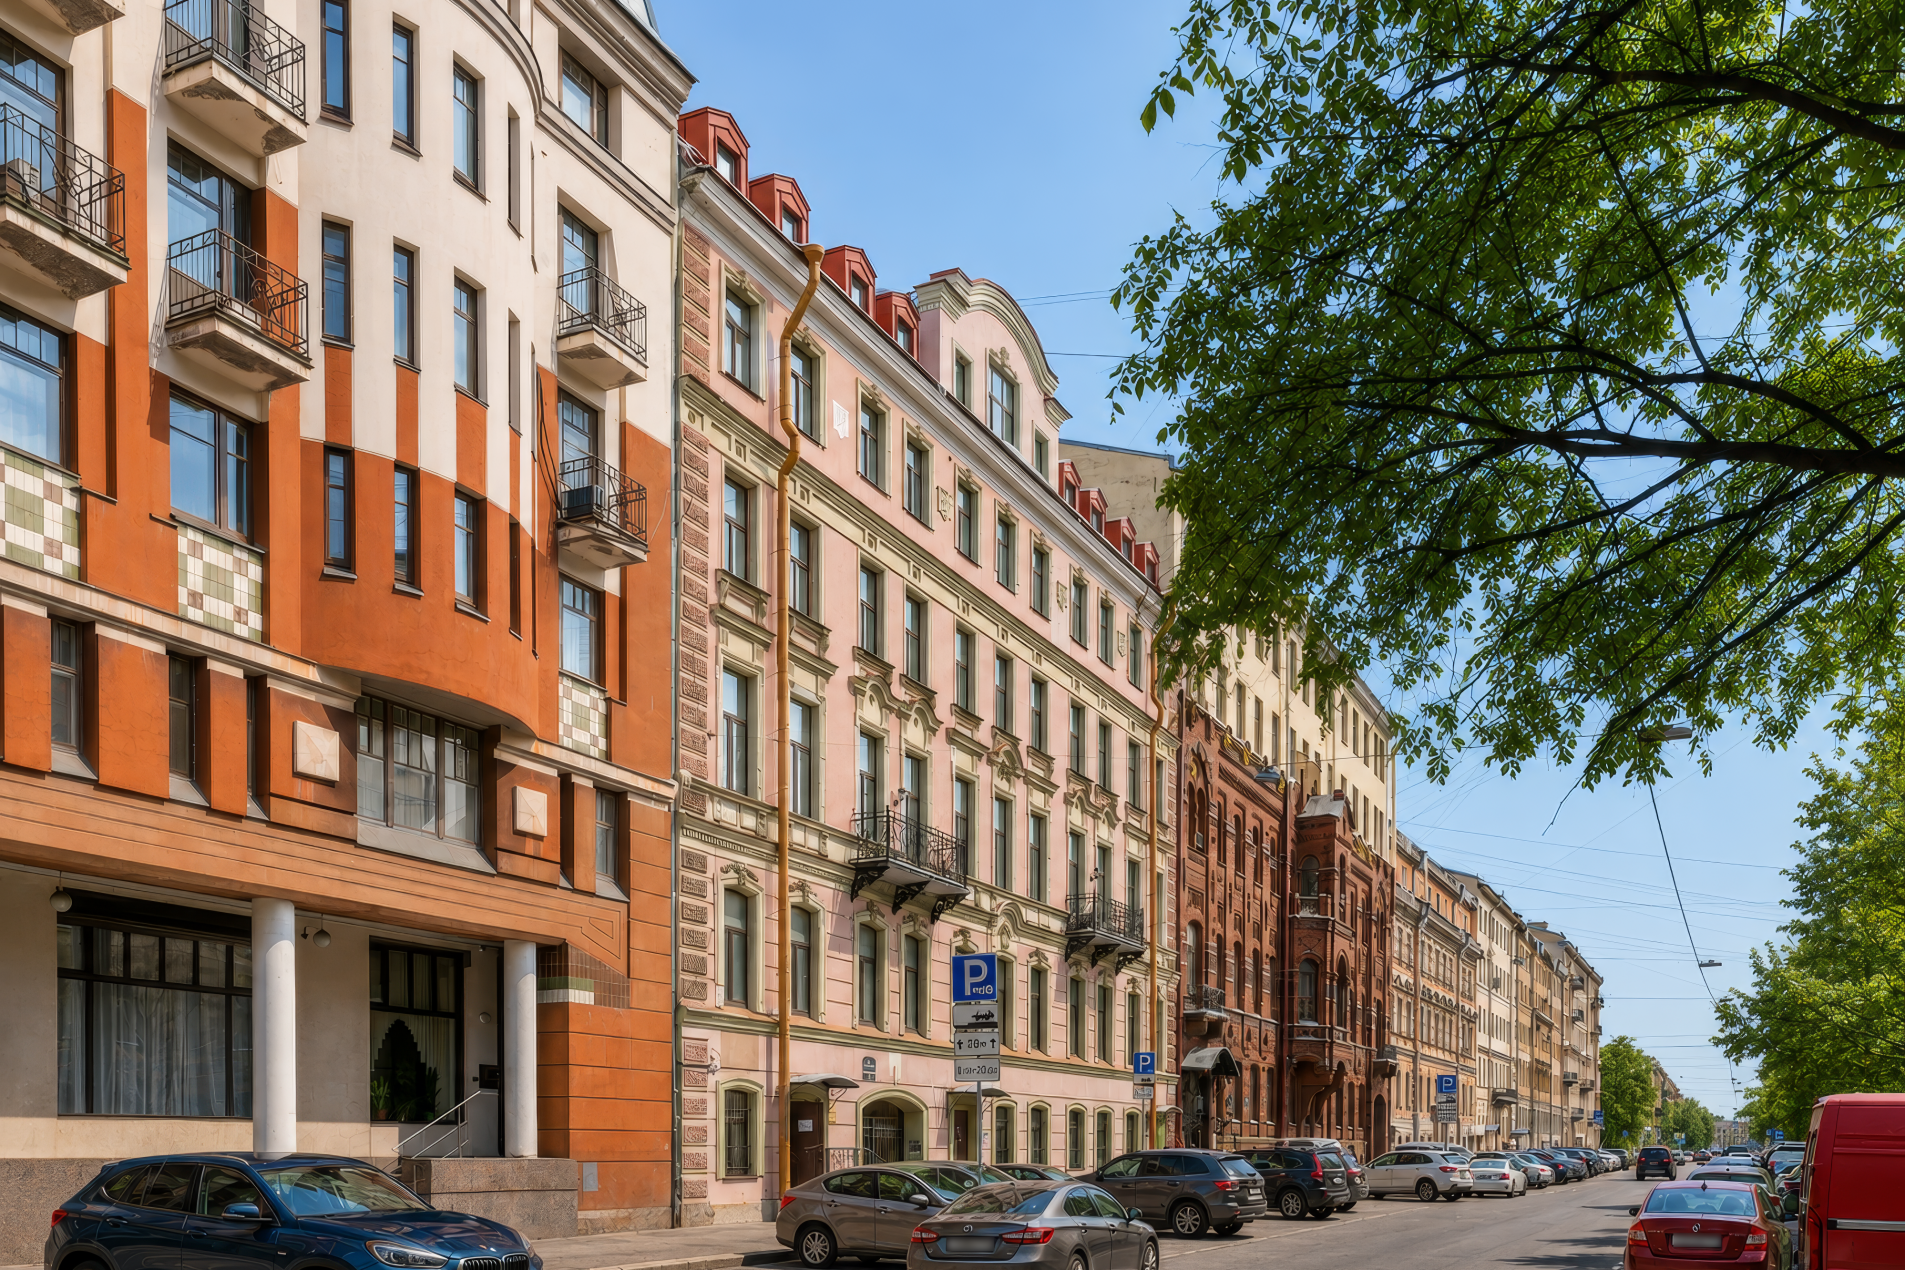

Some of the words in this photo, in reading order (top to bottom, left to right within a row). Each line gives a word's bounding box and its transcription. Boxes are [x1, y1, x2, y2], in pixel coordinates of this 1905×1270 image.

[964, 959, 988, 996] P
[1139, 1054, 1151, 1073] P
[1442, 1077, 1454, 1092] P
